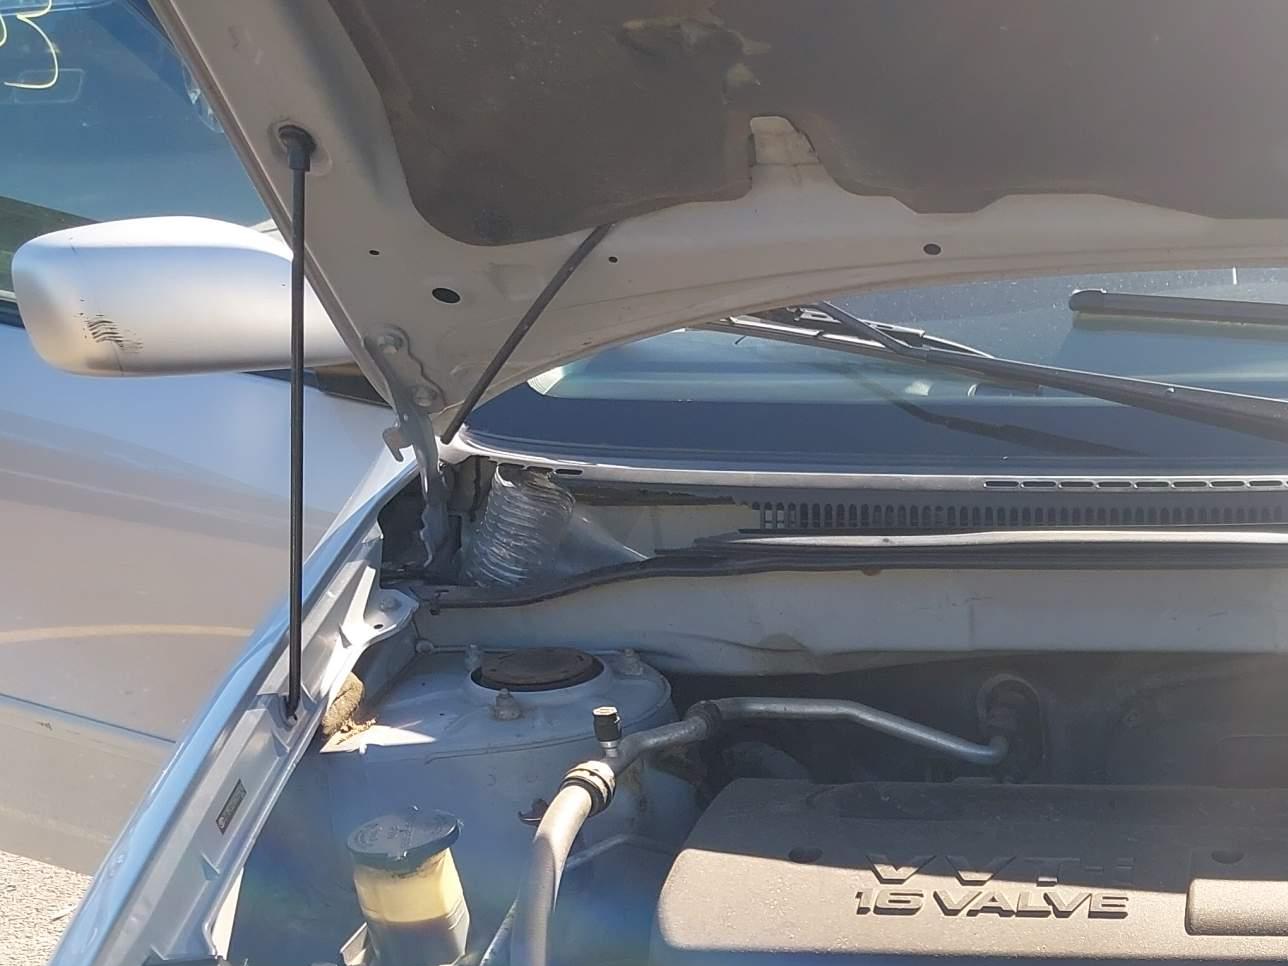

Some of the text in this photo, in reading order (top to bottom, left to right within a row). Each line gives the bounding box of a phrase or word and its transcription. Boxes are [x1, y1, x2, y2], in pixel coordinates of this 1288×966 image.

[0, 0, 59, 89] 3
[854, 889, 1130, 920] 16 VALVE
